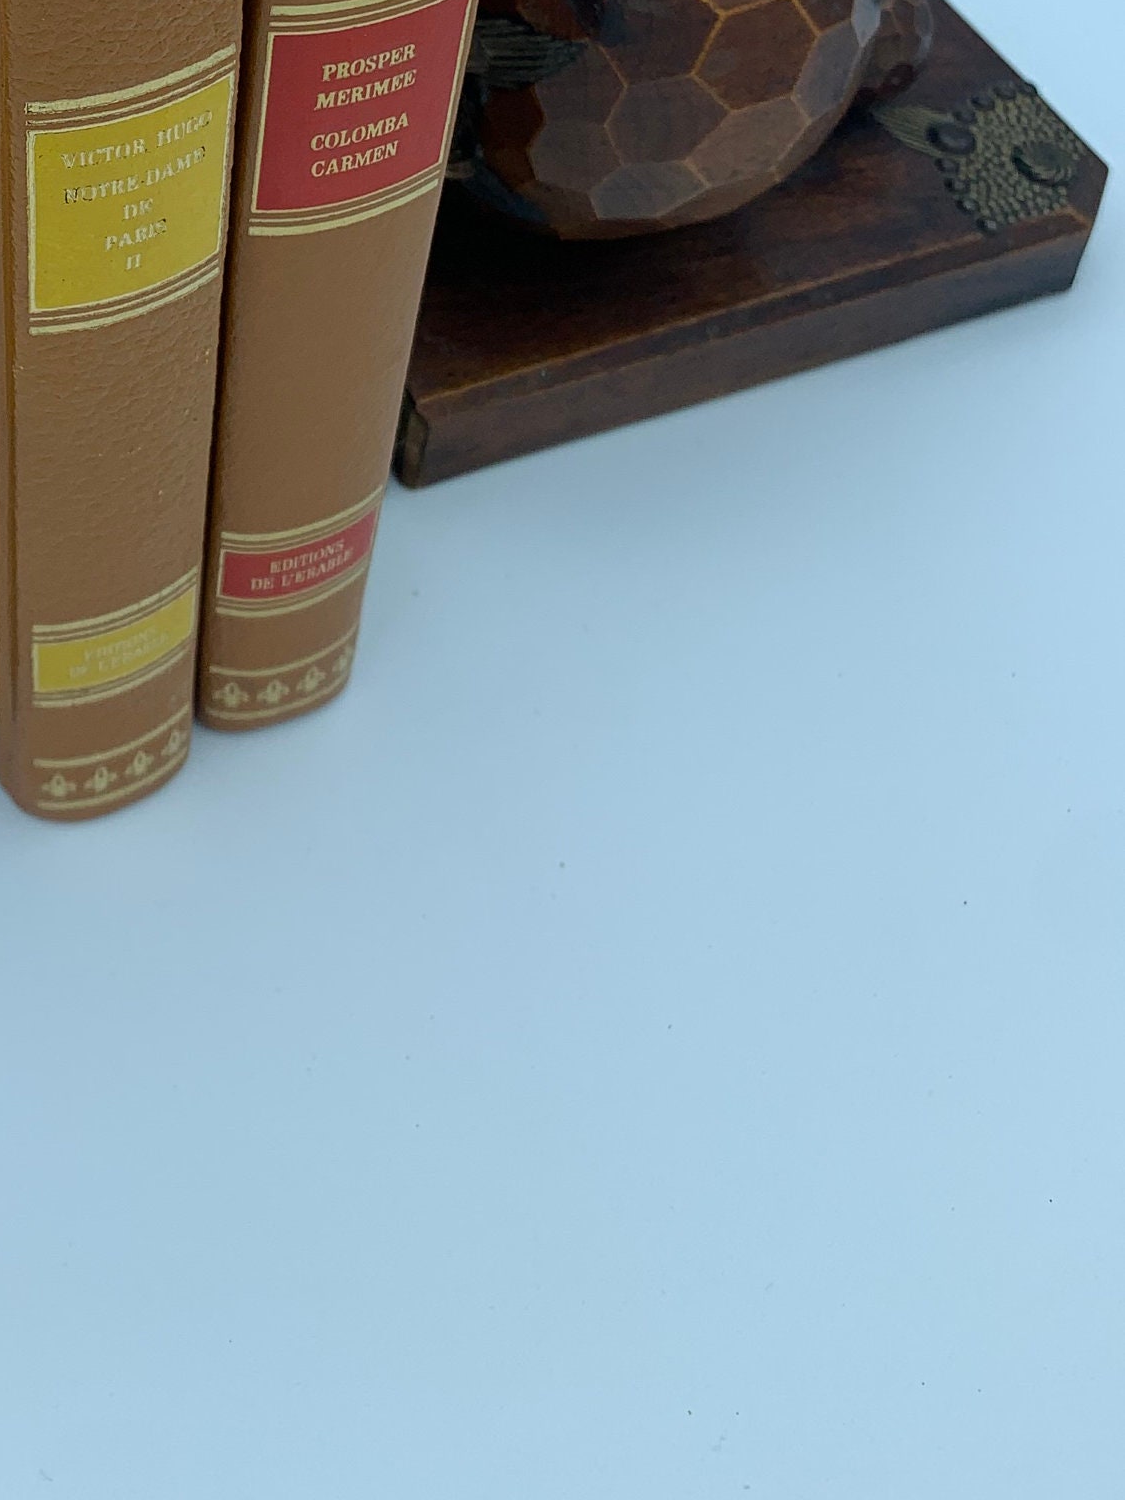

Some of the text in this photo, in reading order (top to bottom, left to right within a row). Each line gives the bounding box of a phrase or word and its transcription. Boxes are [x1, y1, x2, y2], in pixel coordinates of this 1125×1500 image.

[322, 43, 416, 82] PROSPER
[313, 69, 417, 111] MERIMEE
[61, 110, 213, 169] VICTOR HUGO
[310, 112, 409, 151] COLOMBA
[310, 140, 398, 178] CARMEN
[105, 218, 167, 251] PARIS
[270, 539, 344, 574] EDITIONS
[250, 577, 275, 591] DE
